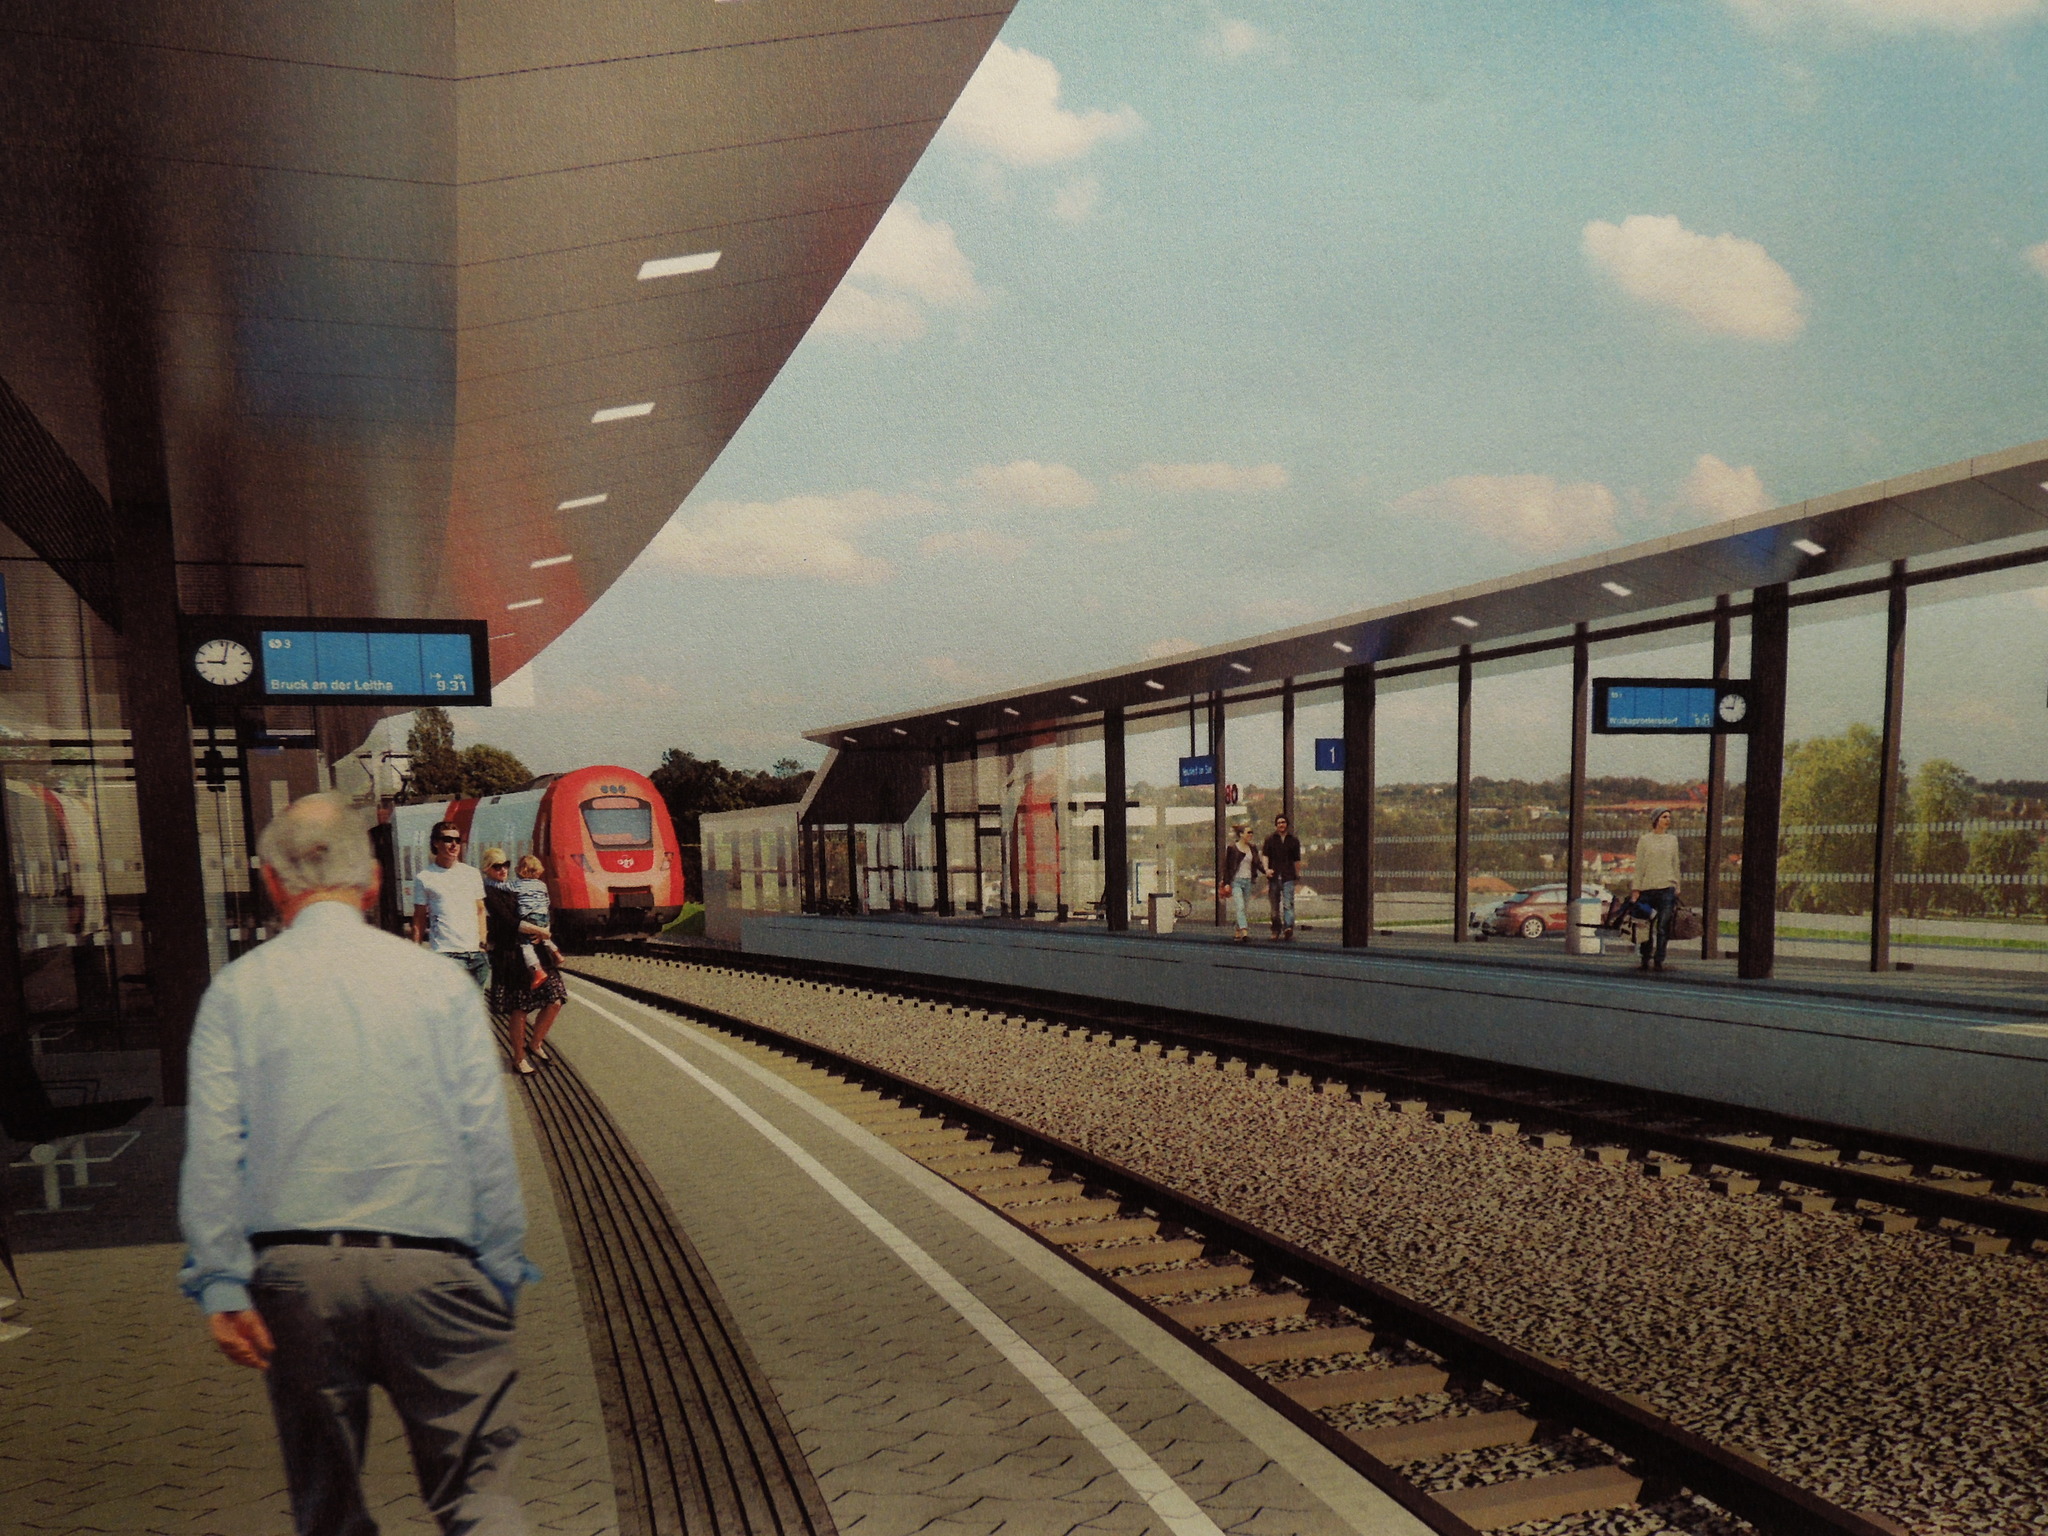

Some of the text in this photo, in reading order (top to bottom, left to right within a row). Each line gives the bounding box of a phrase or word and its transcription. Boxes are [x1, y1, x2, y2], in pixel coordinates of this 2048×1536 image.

[271, 679, 394, 691] Bruck an der Leitha
[436, 680, 467, 692] 9:31
[1330, 746, 1335, 764] 1
